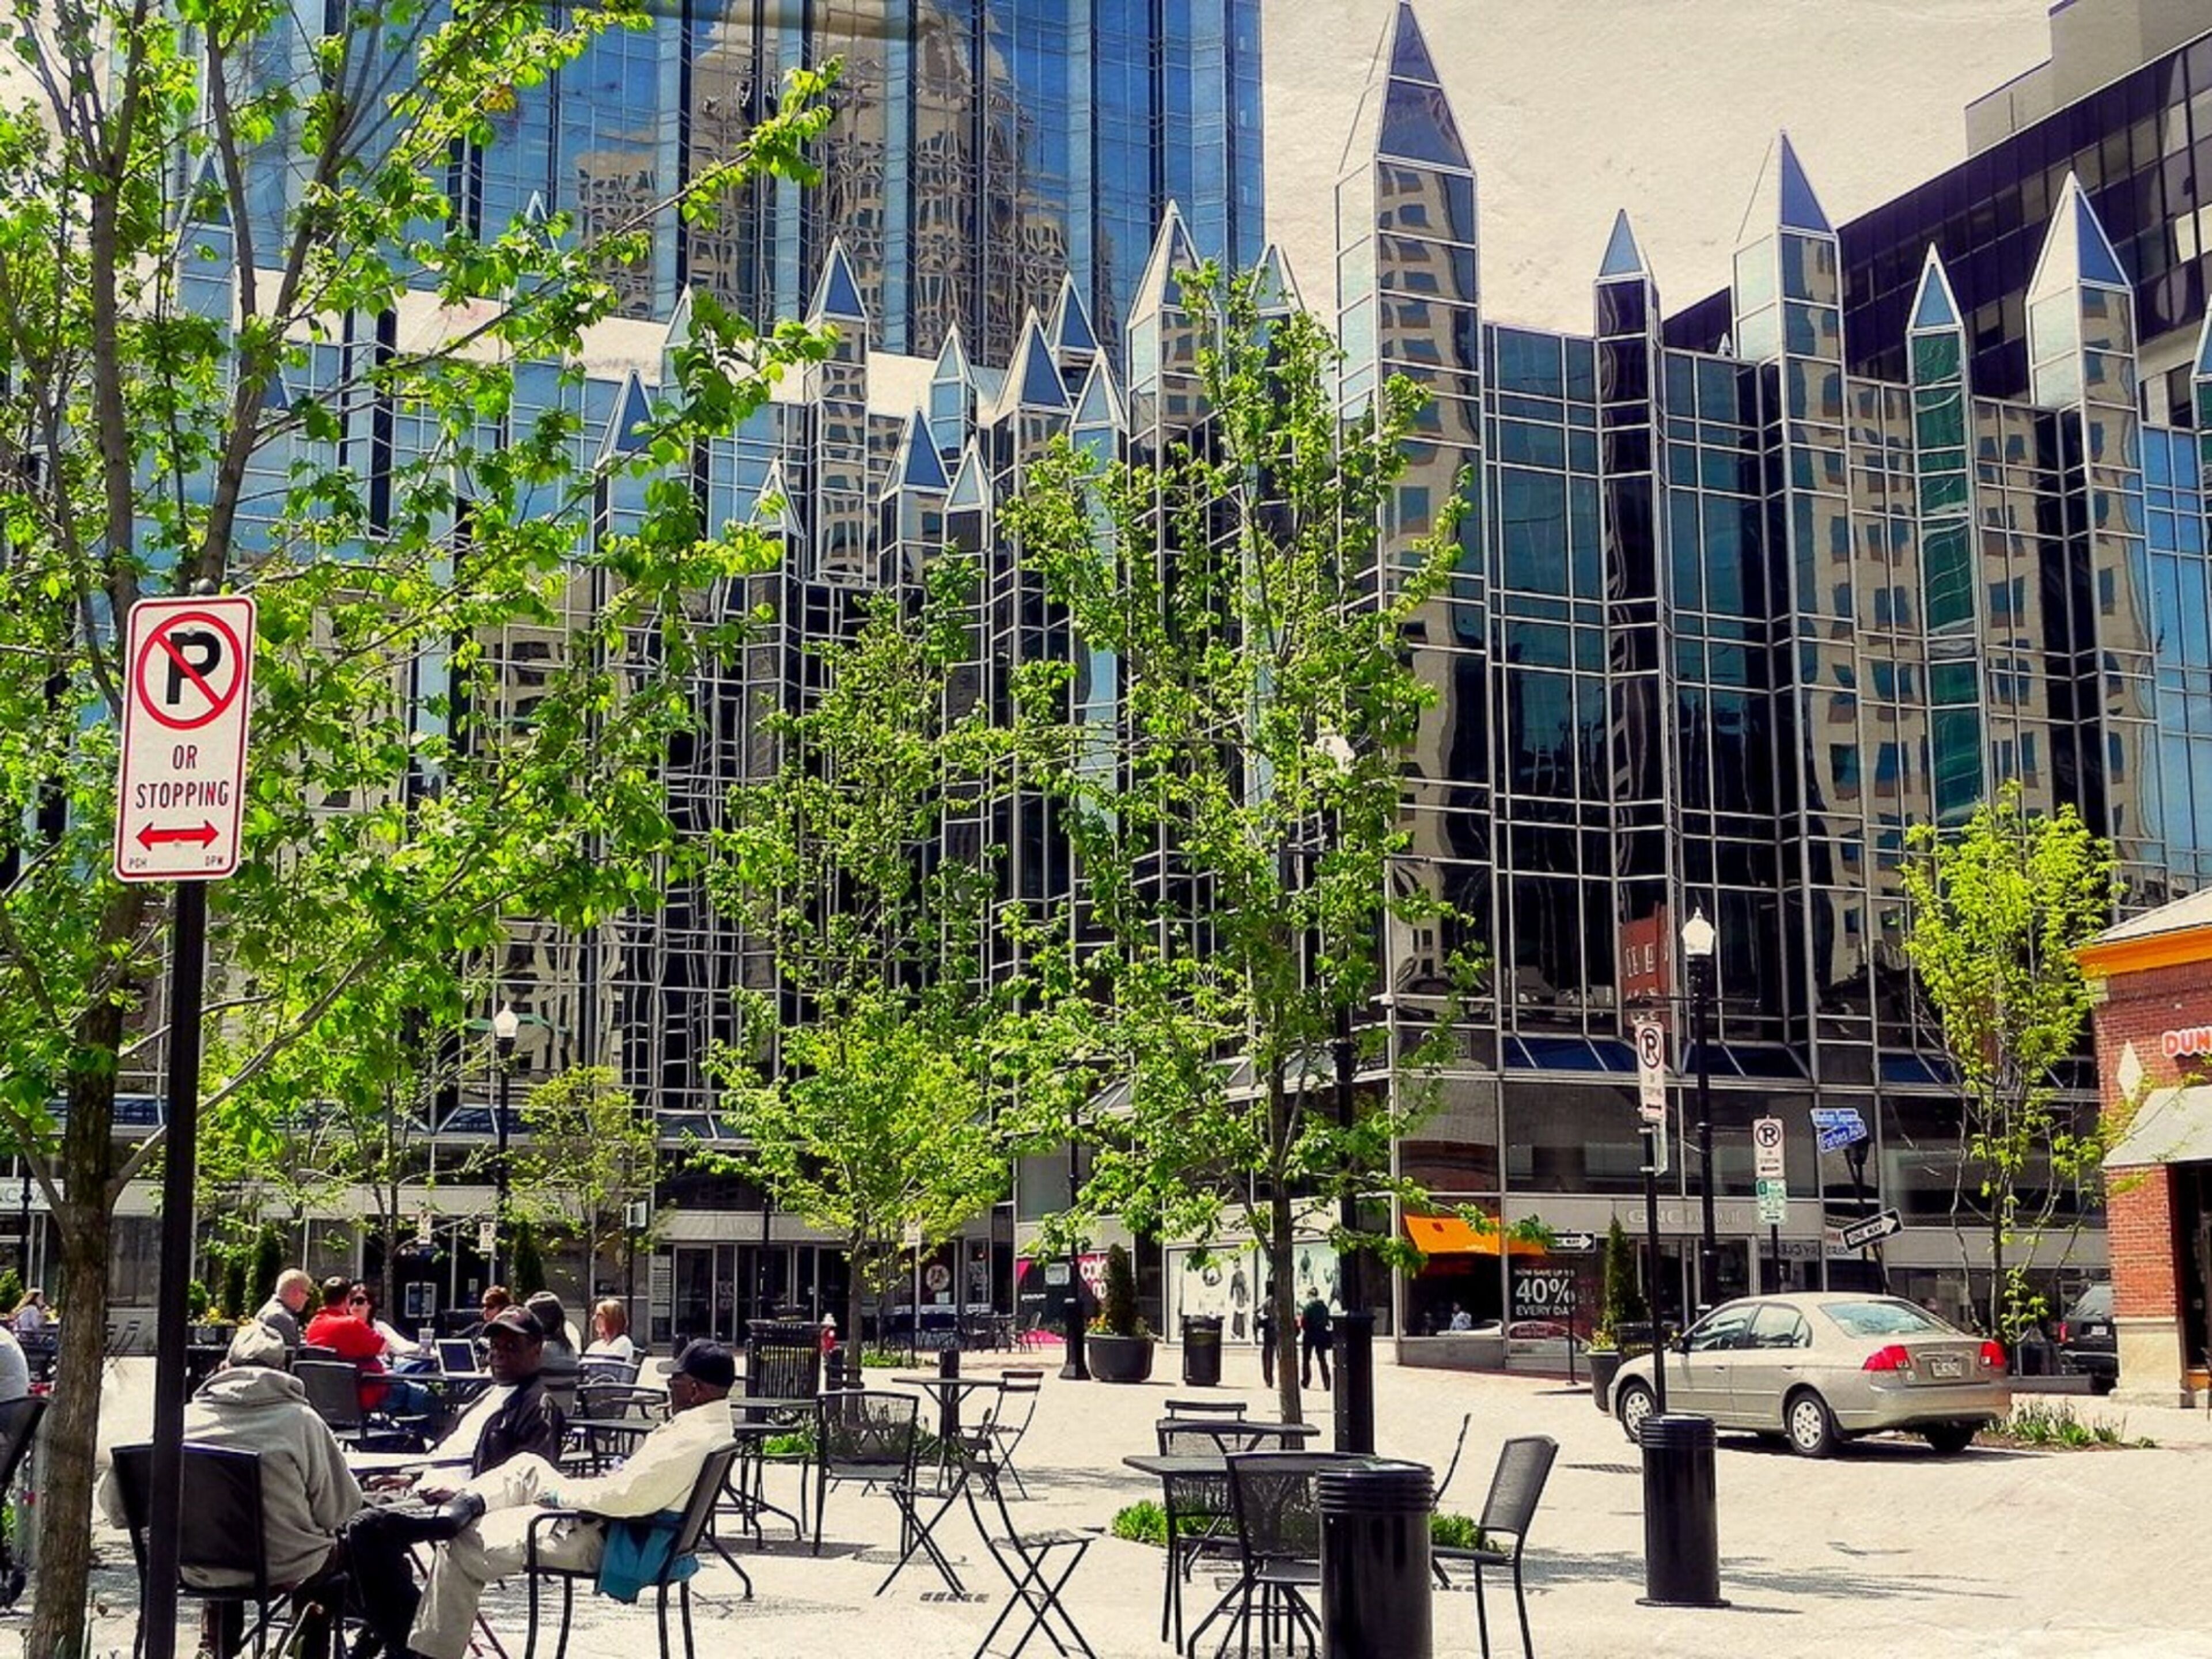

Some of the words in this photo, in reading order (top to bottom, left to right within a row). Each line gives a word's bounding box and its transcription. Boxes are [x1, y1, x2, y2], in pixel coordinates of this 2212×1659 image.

[166, 631, 221, 704] P
[173, 744, 198, 770] OR
[136, 780, 229, 809] STOPPING
[1516, 1278, 1575, 1304] 40%
[1516, 1304, 1552, 1316] EVERY
